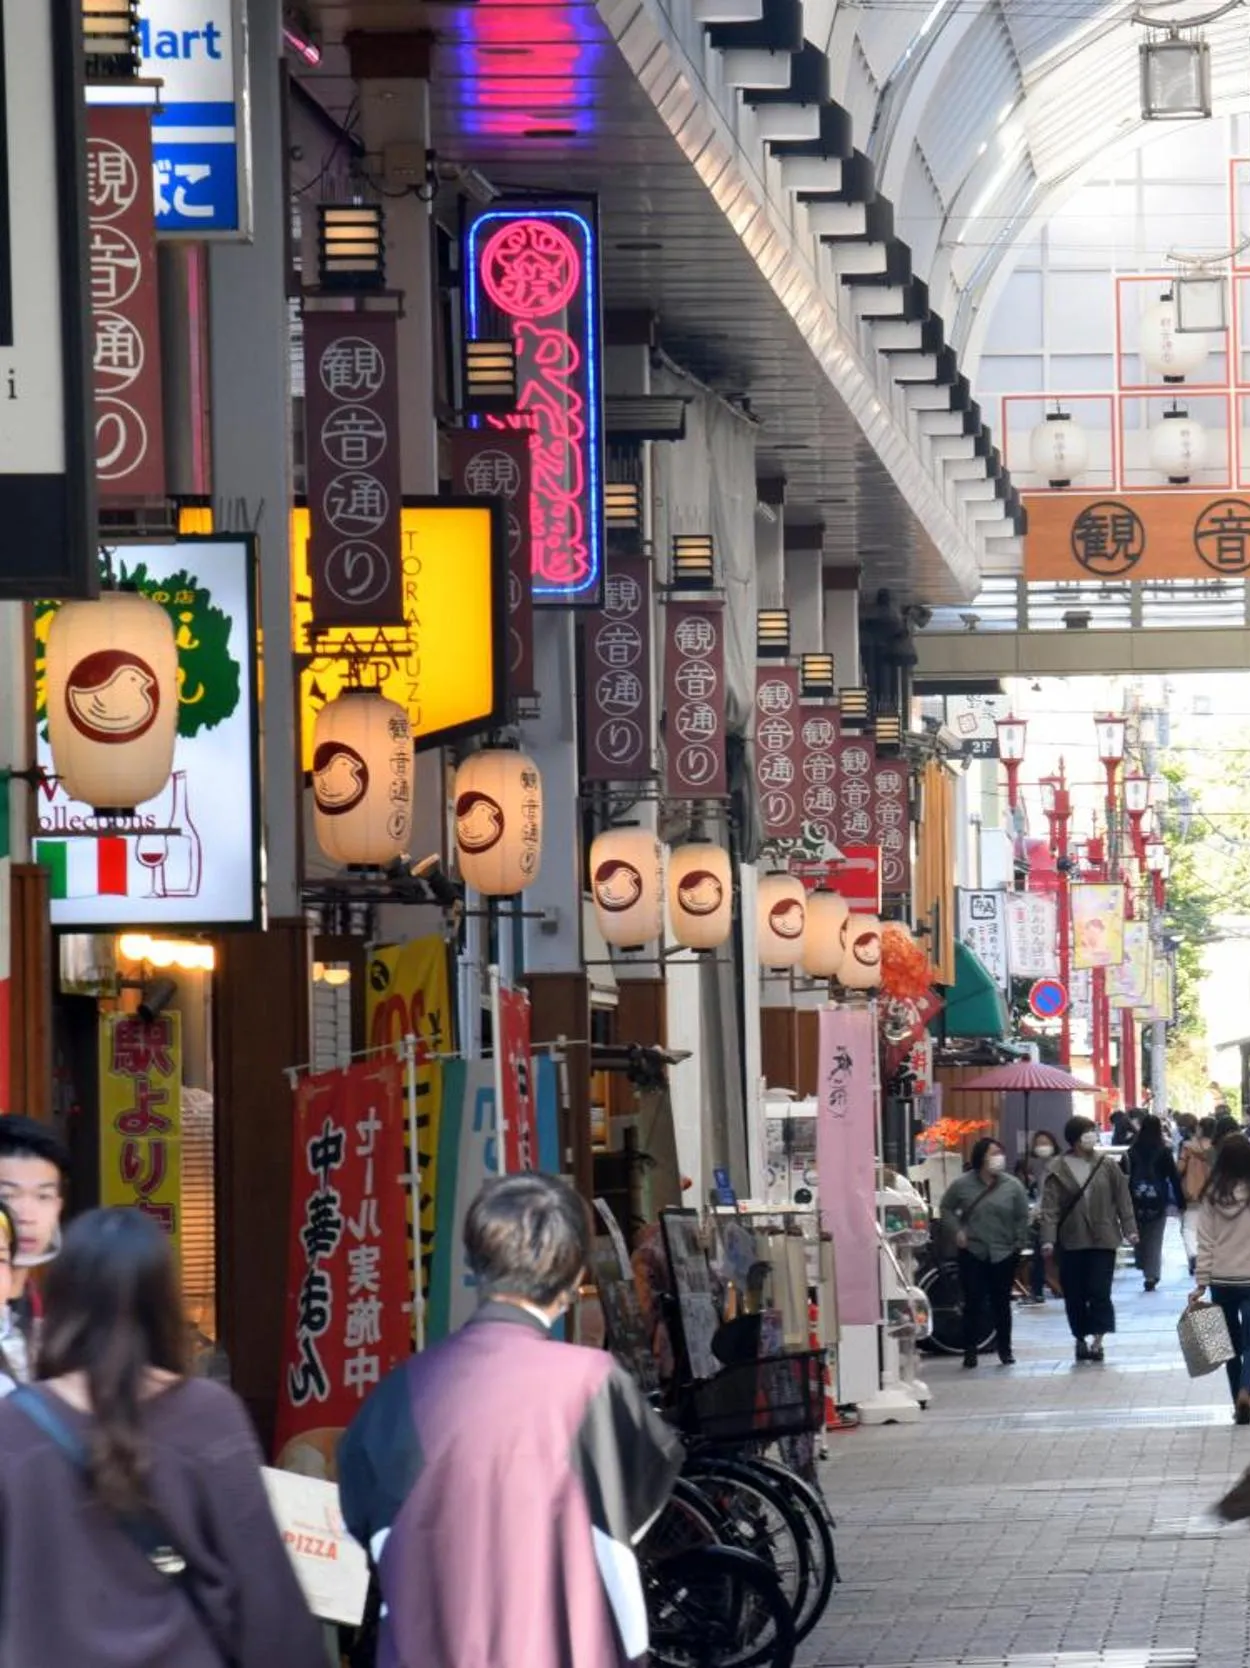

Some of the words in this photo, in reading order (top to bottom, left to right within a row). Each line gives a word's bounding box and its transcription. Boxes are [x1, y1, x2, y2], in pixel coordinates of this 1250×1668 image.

[320, 336, 390, 605] 観音通り
[596, 574, 643, 763] 観音通り
[675, 617, 718, 785] 観音通り
[757, 680, 794, 827] 観音通り
[841, 747, 871, 847] 観音通
[282, 1529, 339, 1561] PIZZA
